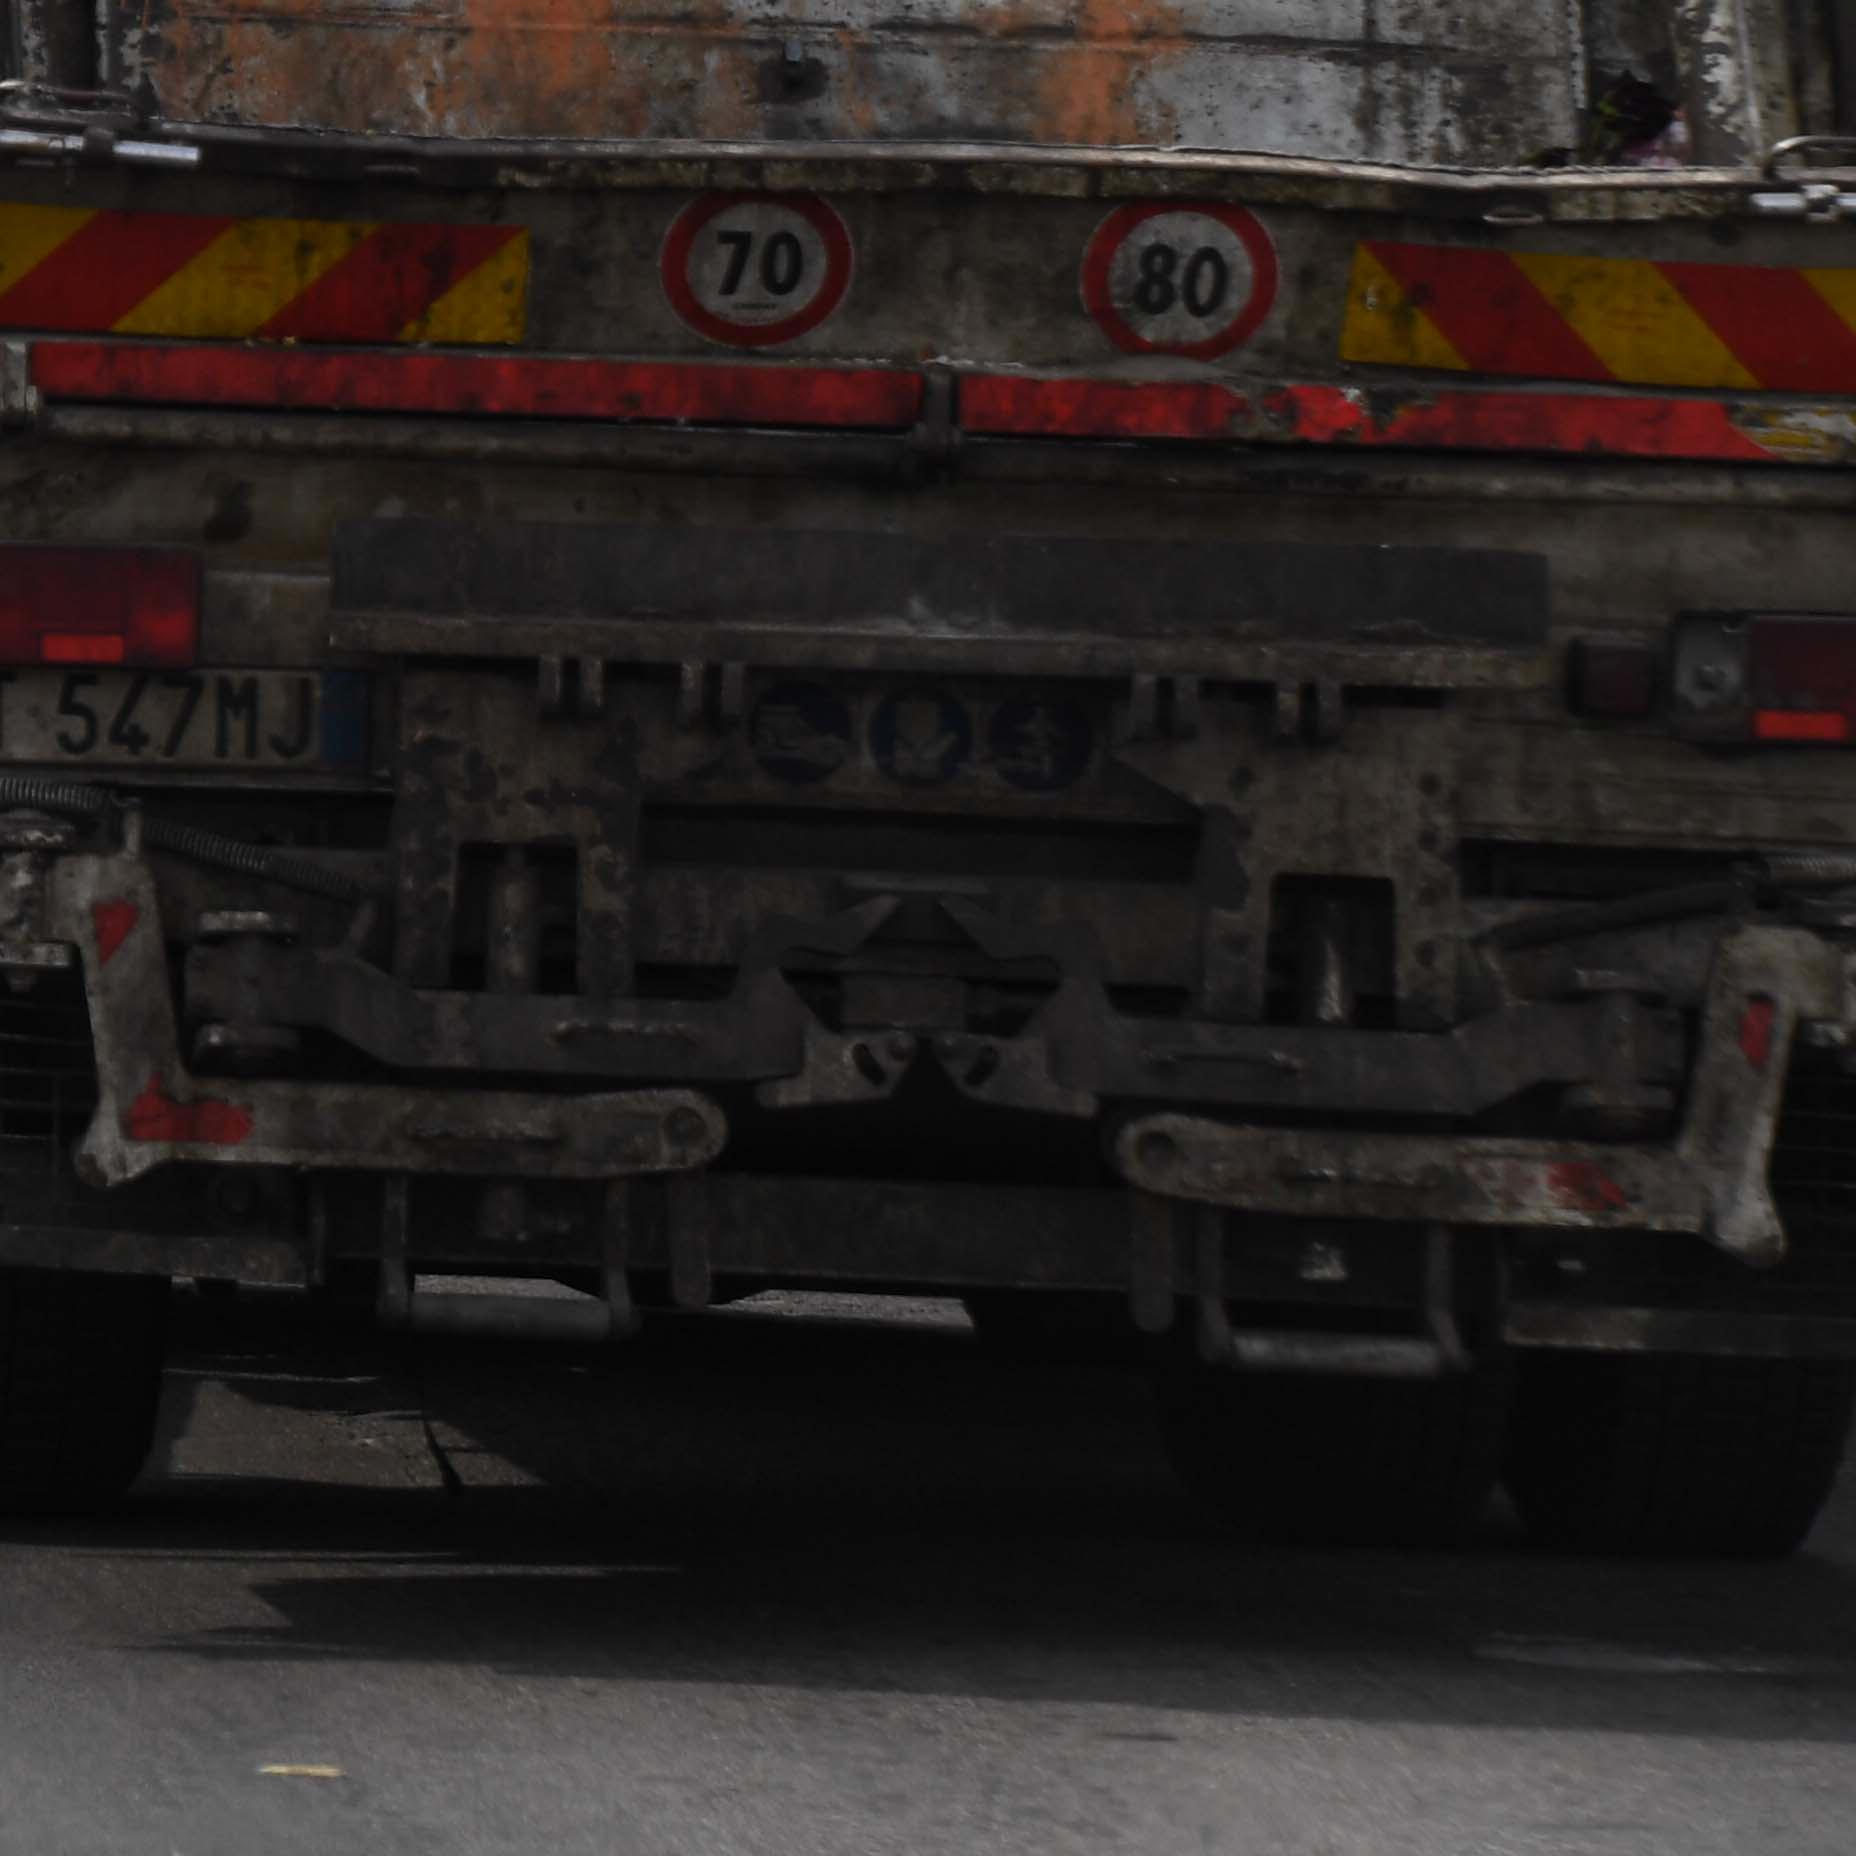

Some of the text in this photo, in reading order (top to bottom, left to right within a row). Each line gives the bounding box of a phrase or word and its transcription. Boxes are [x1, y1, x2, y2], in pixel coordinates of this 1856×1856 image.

[717, 230, 804, 296] 70
[1132, 241, 1230, 318] 80
[56, 673, 313, 759] 547MJ
